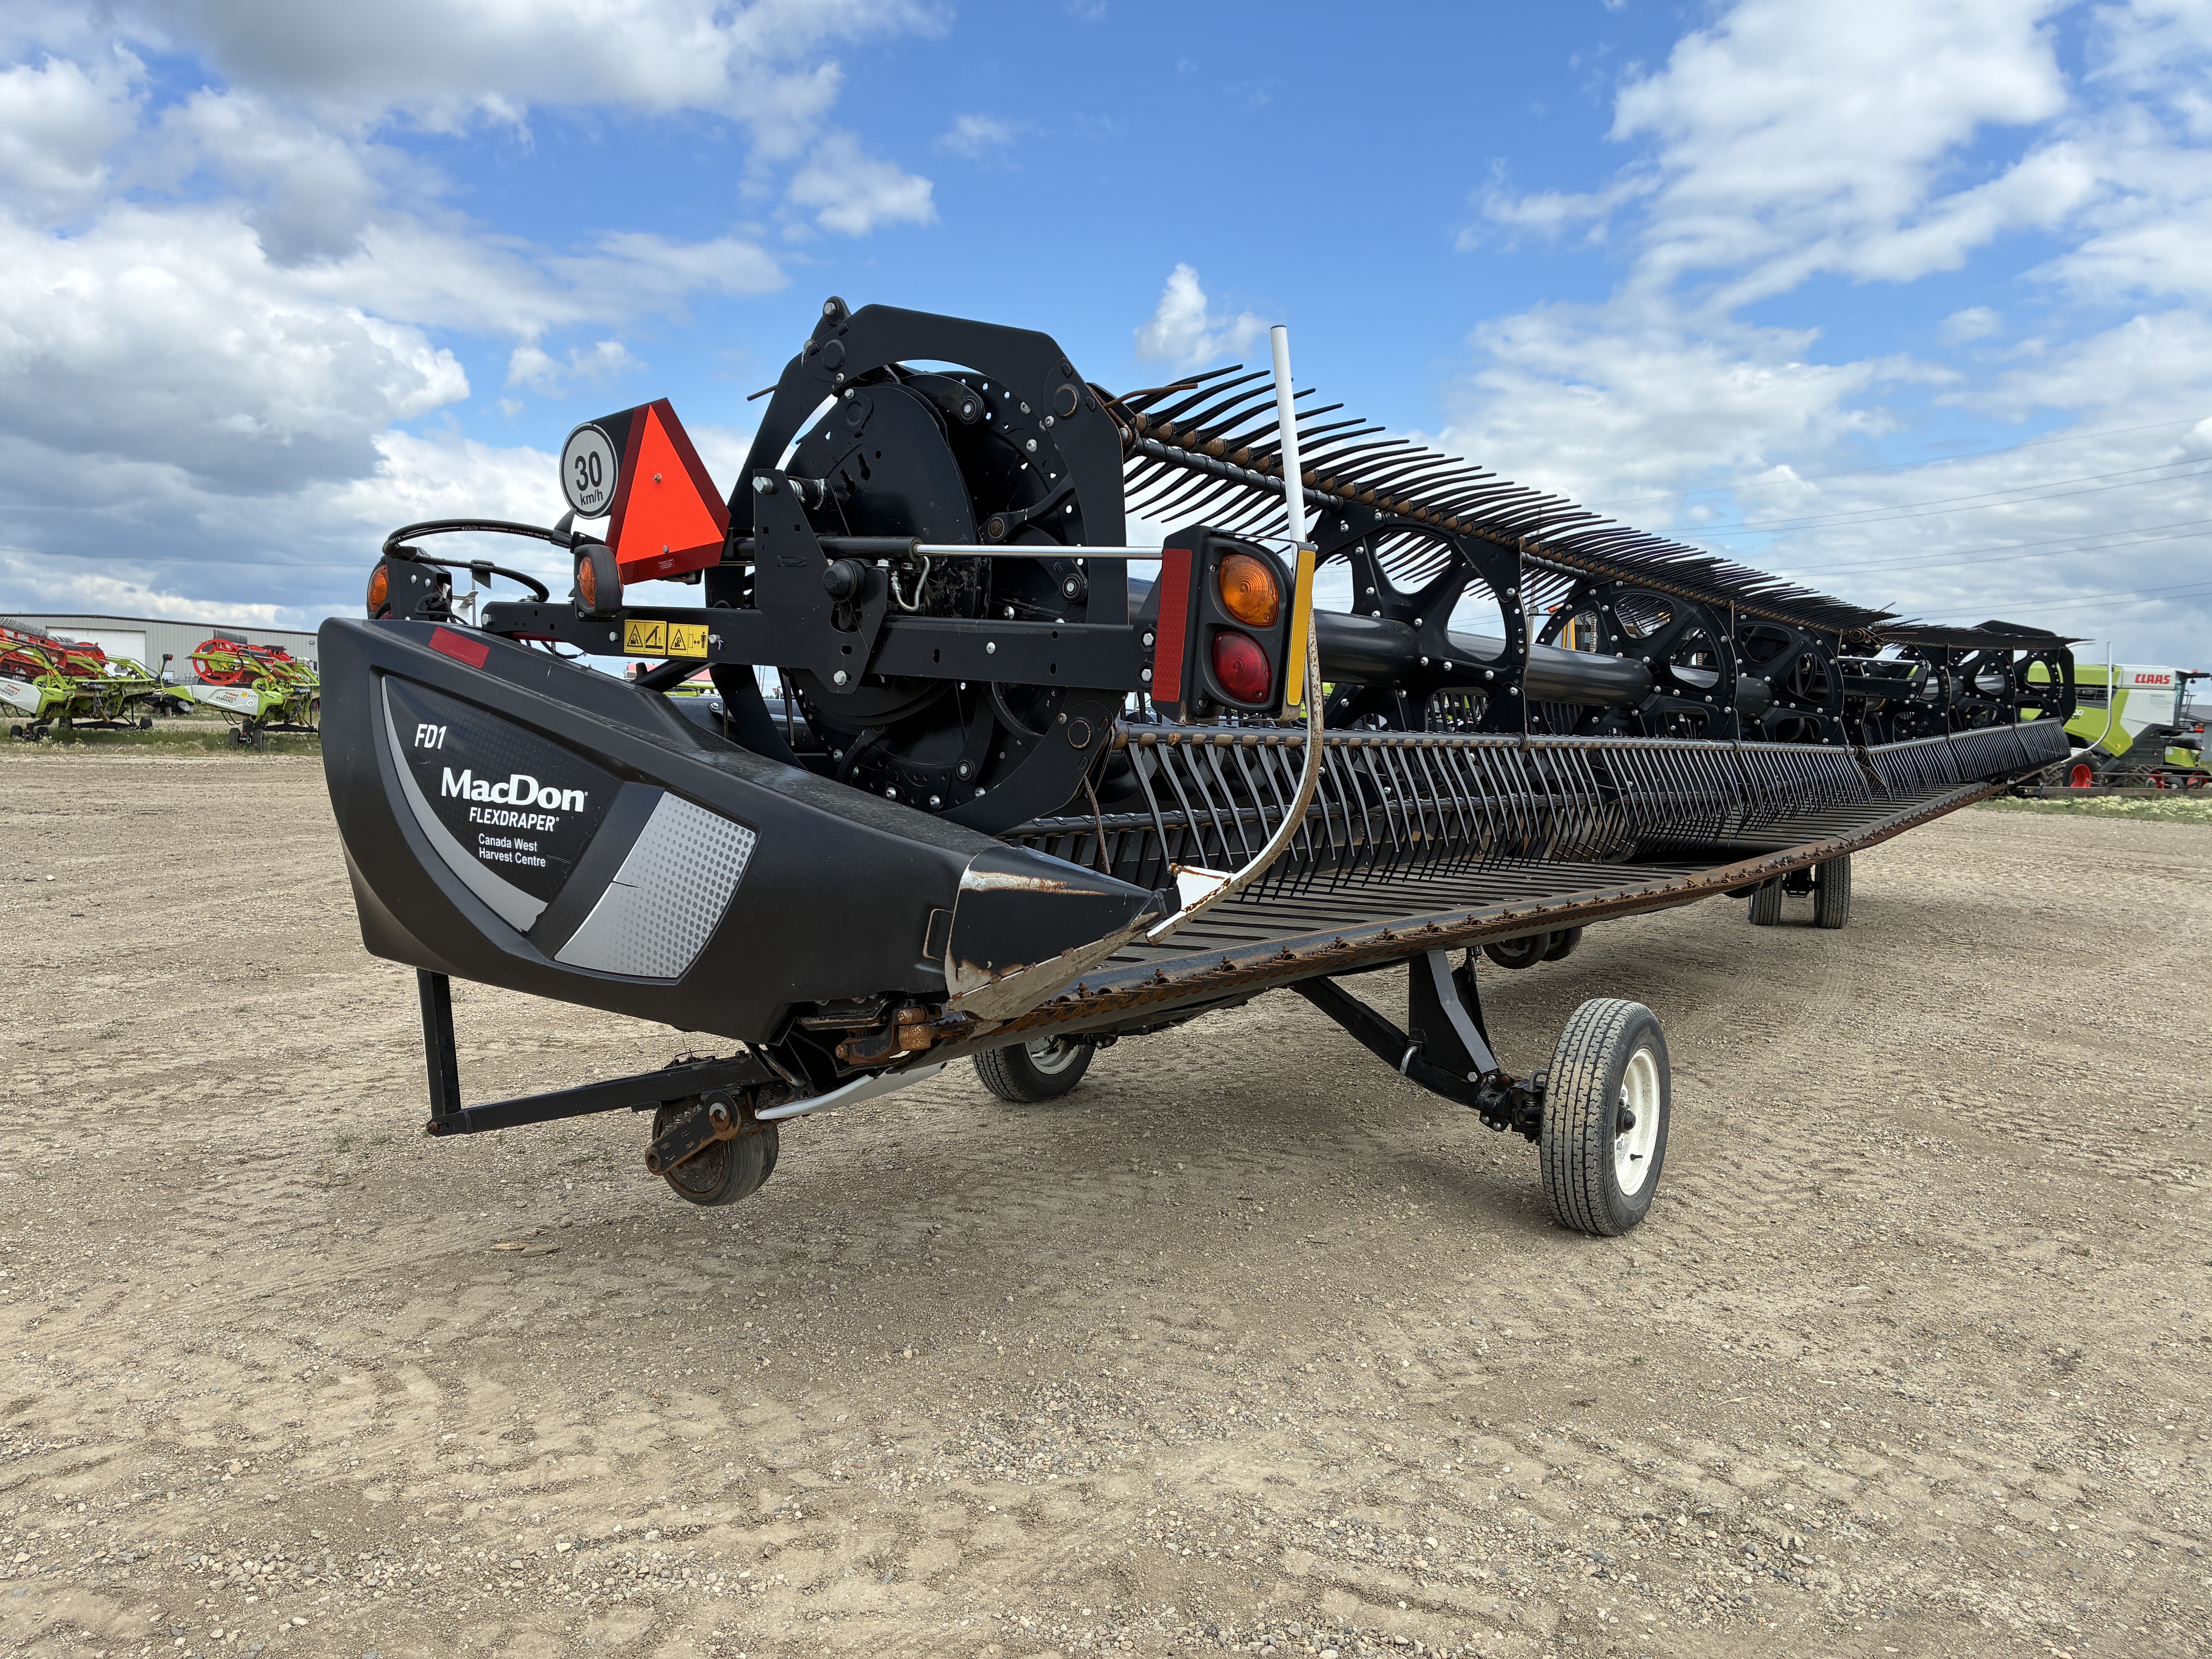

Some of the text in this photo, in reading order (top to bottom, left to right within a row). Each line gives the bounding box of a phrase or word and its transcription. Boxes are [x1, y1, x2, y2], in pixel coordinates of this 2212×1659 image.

[575, 451, 602, 491] 30
[580, 489, 603, 506] km/h
[2135, 674, 2171, 684] CLAAS
[414, 723, 447, 749] FD1
[441, 767, 584, 812] MacDon
[469, 807, 555, 832] FLEXDRAPER
[478, 833, 538, 852] Canada West
[479, 847, 546, 867] Harvest Centre
